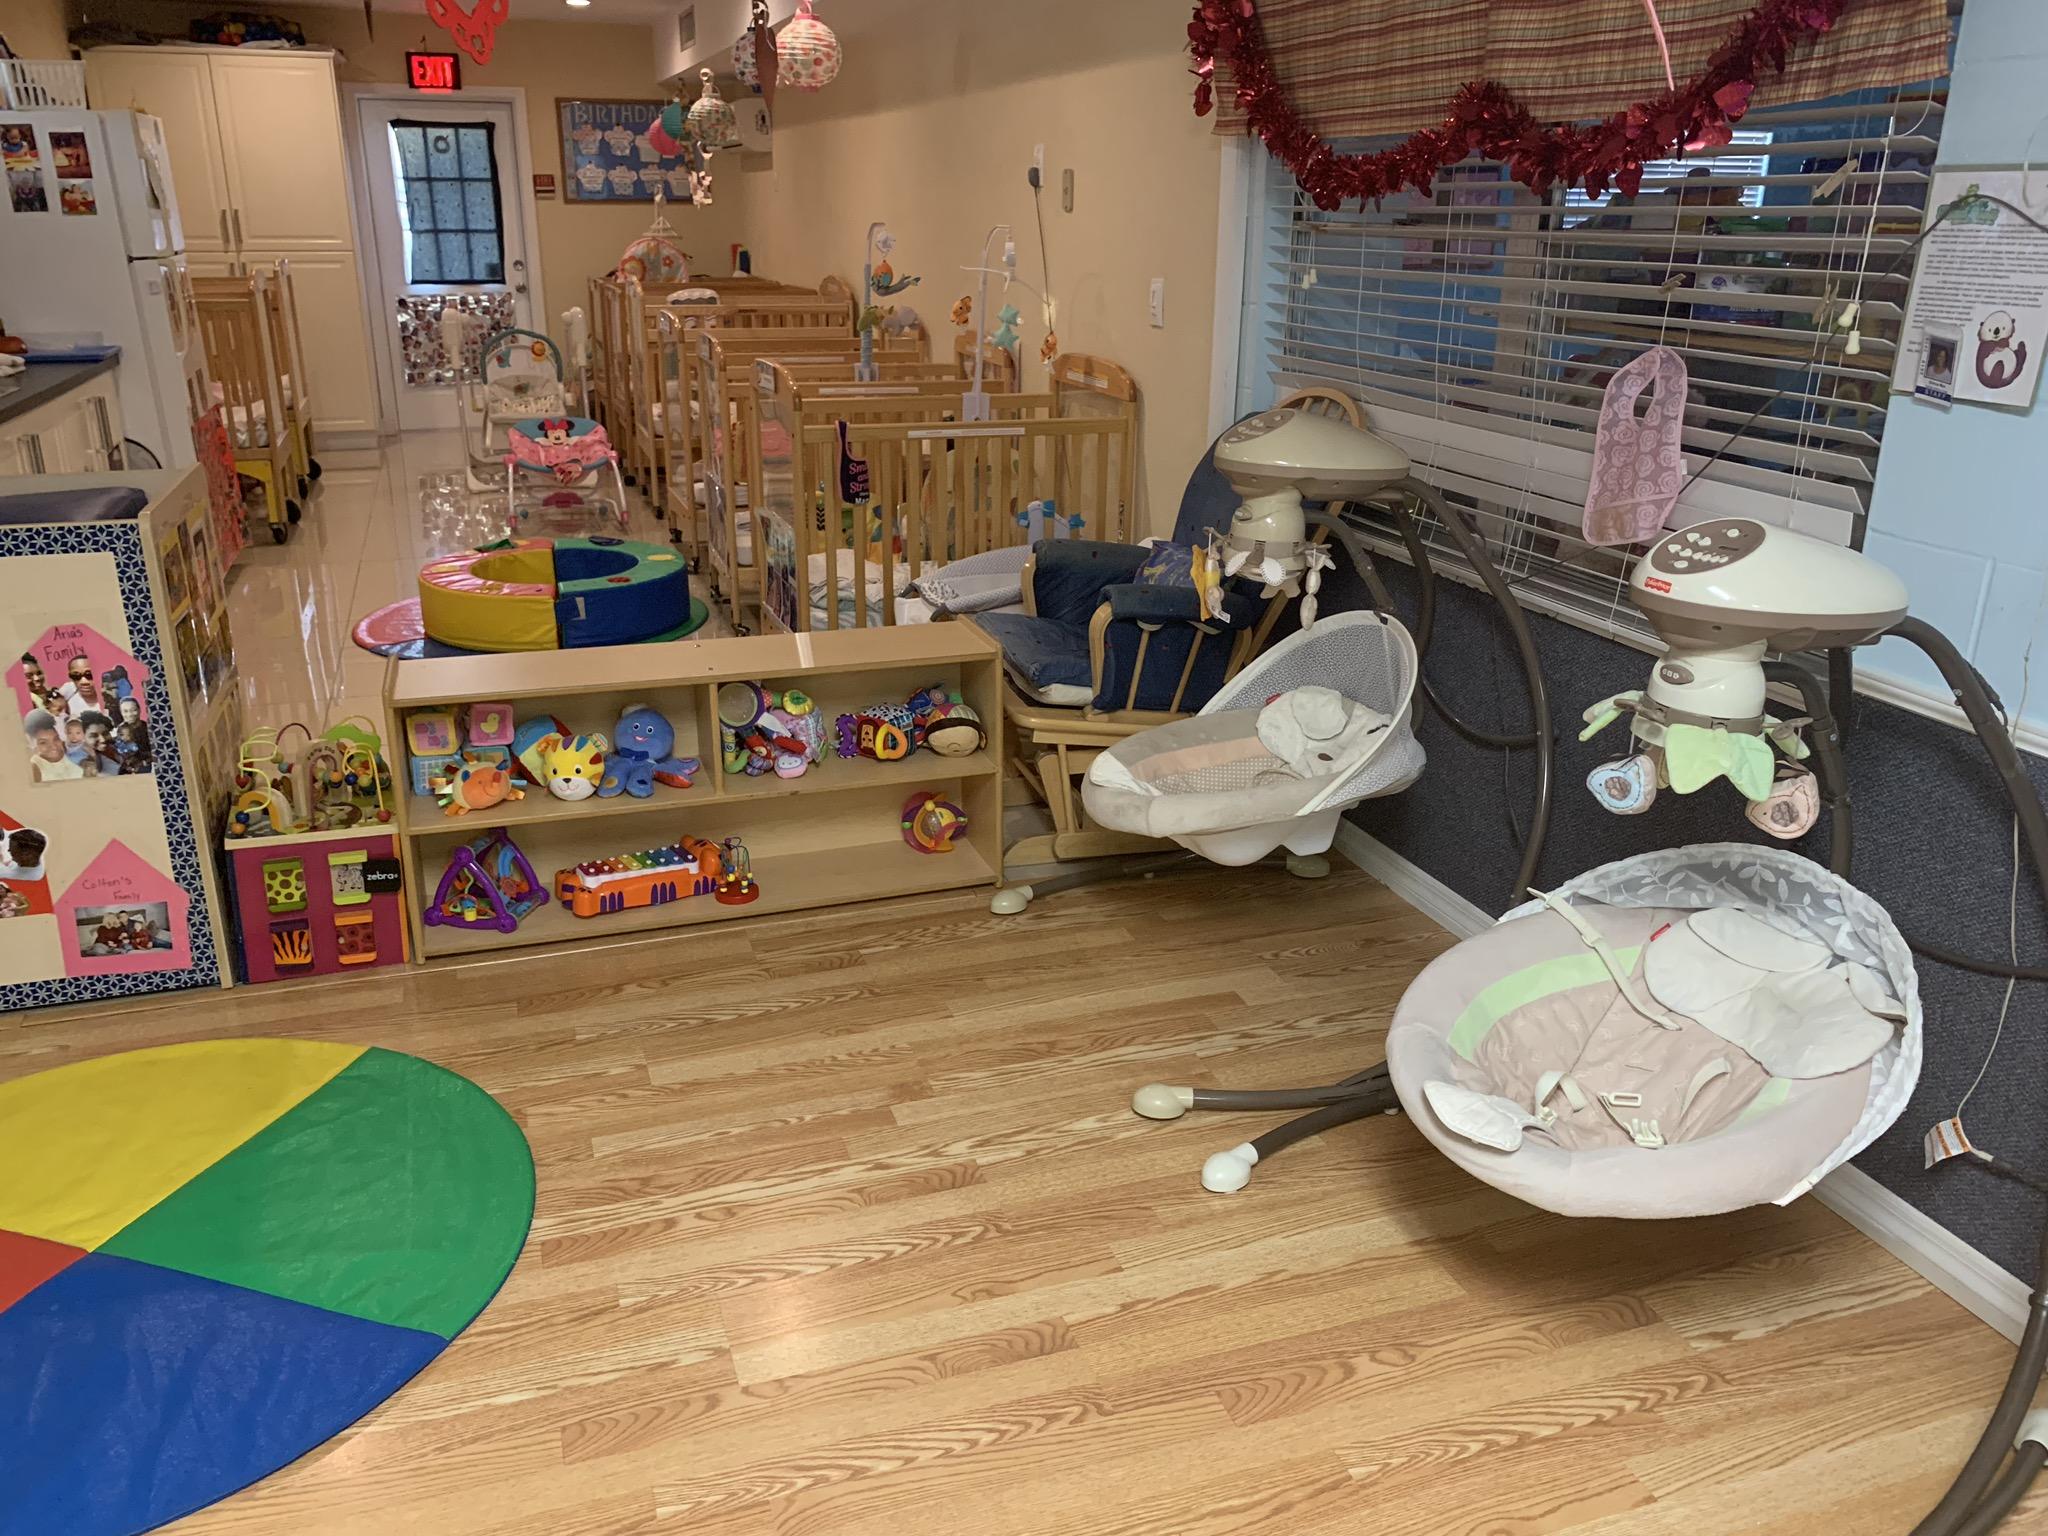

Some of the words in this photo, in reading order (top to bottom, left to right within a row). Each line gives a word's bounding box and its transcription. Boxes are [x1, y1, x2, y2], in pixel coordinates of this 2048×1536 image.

[411, 55, 454, 87] EXIT
[43, 641, 85, 662] Family
[366, 870, 394, 881] zebra
